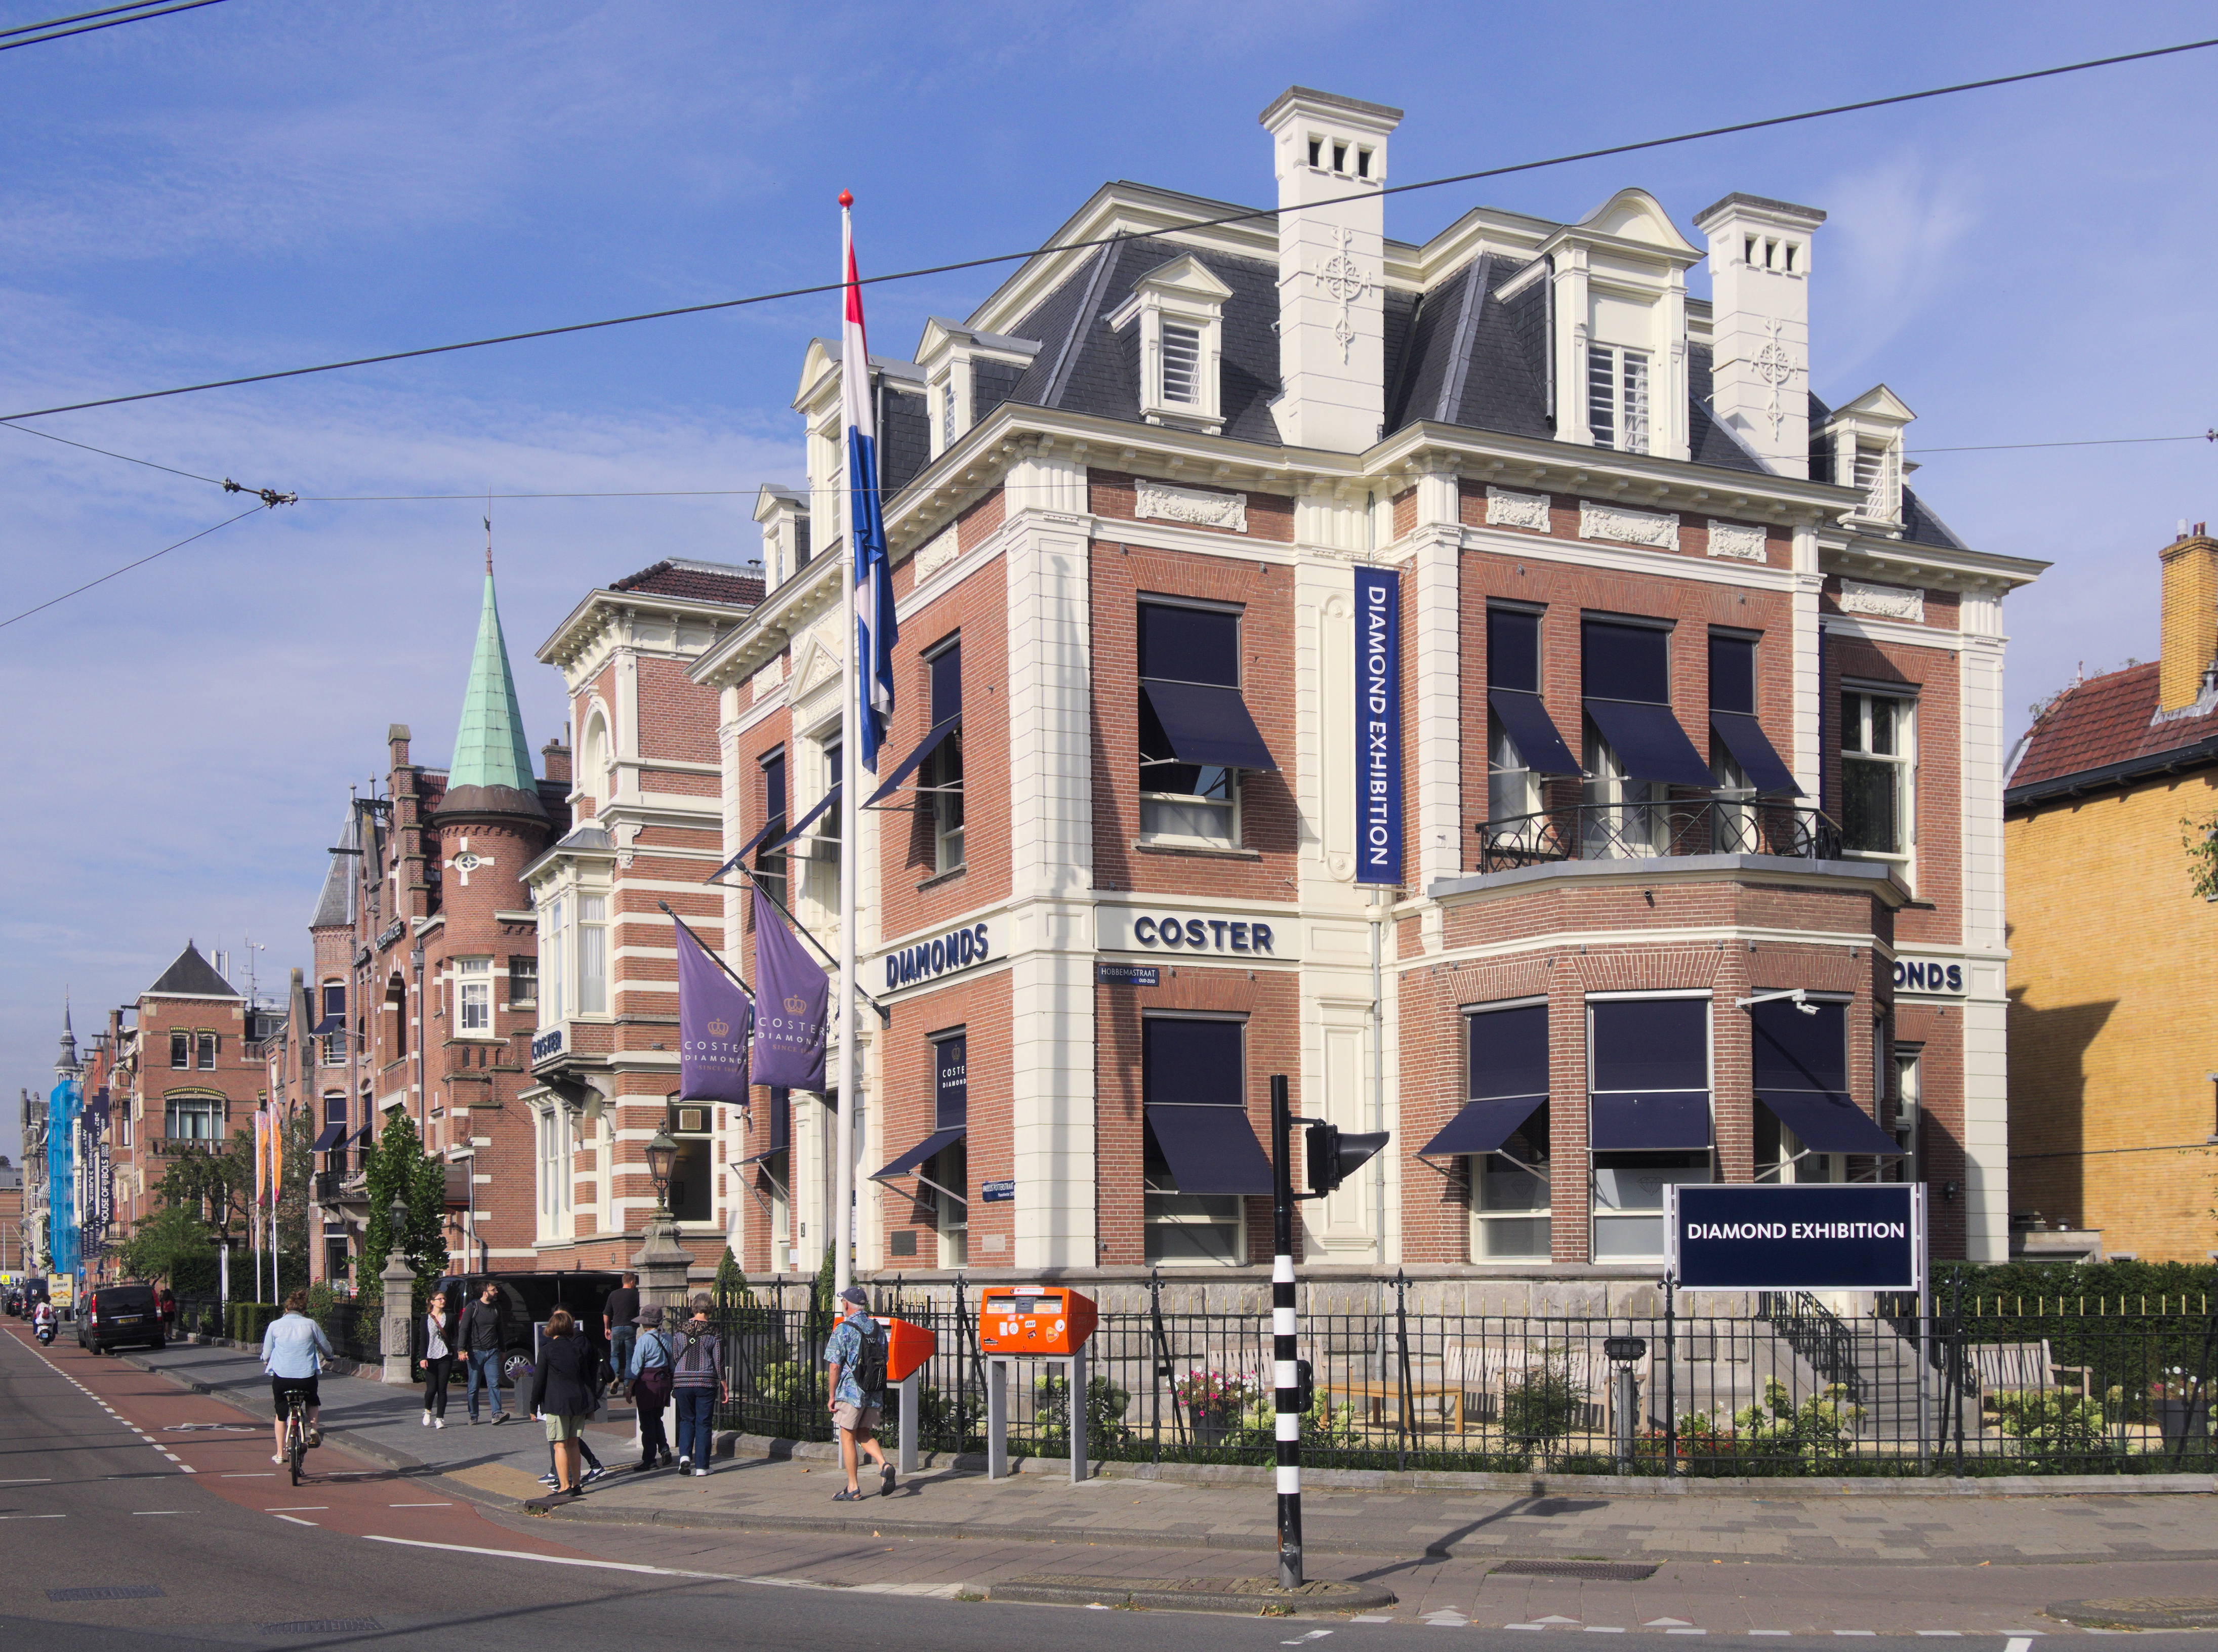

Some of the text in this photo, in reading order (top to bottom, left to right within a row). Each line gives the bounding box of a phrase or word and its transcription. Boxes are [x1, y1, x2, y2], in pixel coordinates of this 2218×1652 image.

[1369, 586, 1387, 864] DIAMOND EXHIBITION
[1134, 916, 1271, 950] COSTER
[886, 923, 989, 987] DIAMONDS
[1101, 968, 1155, 977] HOBBEMASTRAAT
[759, 1017, 825, 1036] COSTER
[531, 1030, 562, 1059] COSTER
[759, 1032, 825, 1048] DIAMONDS
[684, 1041, 747, 1054] COSTER
[772, 1044, 797, 1052] SINCE
[685, 1055, 747, 1065] DIAMONDS
[101, 1186, 109, 1197] OF
[983, 1182, 1014, 1192] PAULUS POTTERSTRAAT
[801, 1225, 804, 1235] 2
[1688, 1223, 1904, 1239] DIAMOND EXHIBITION
